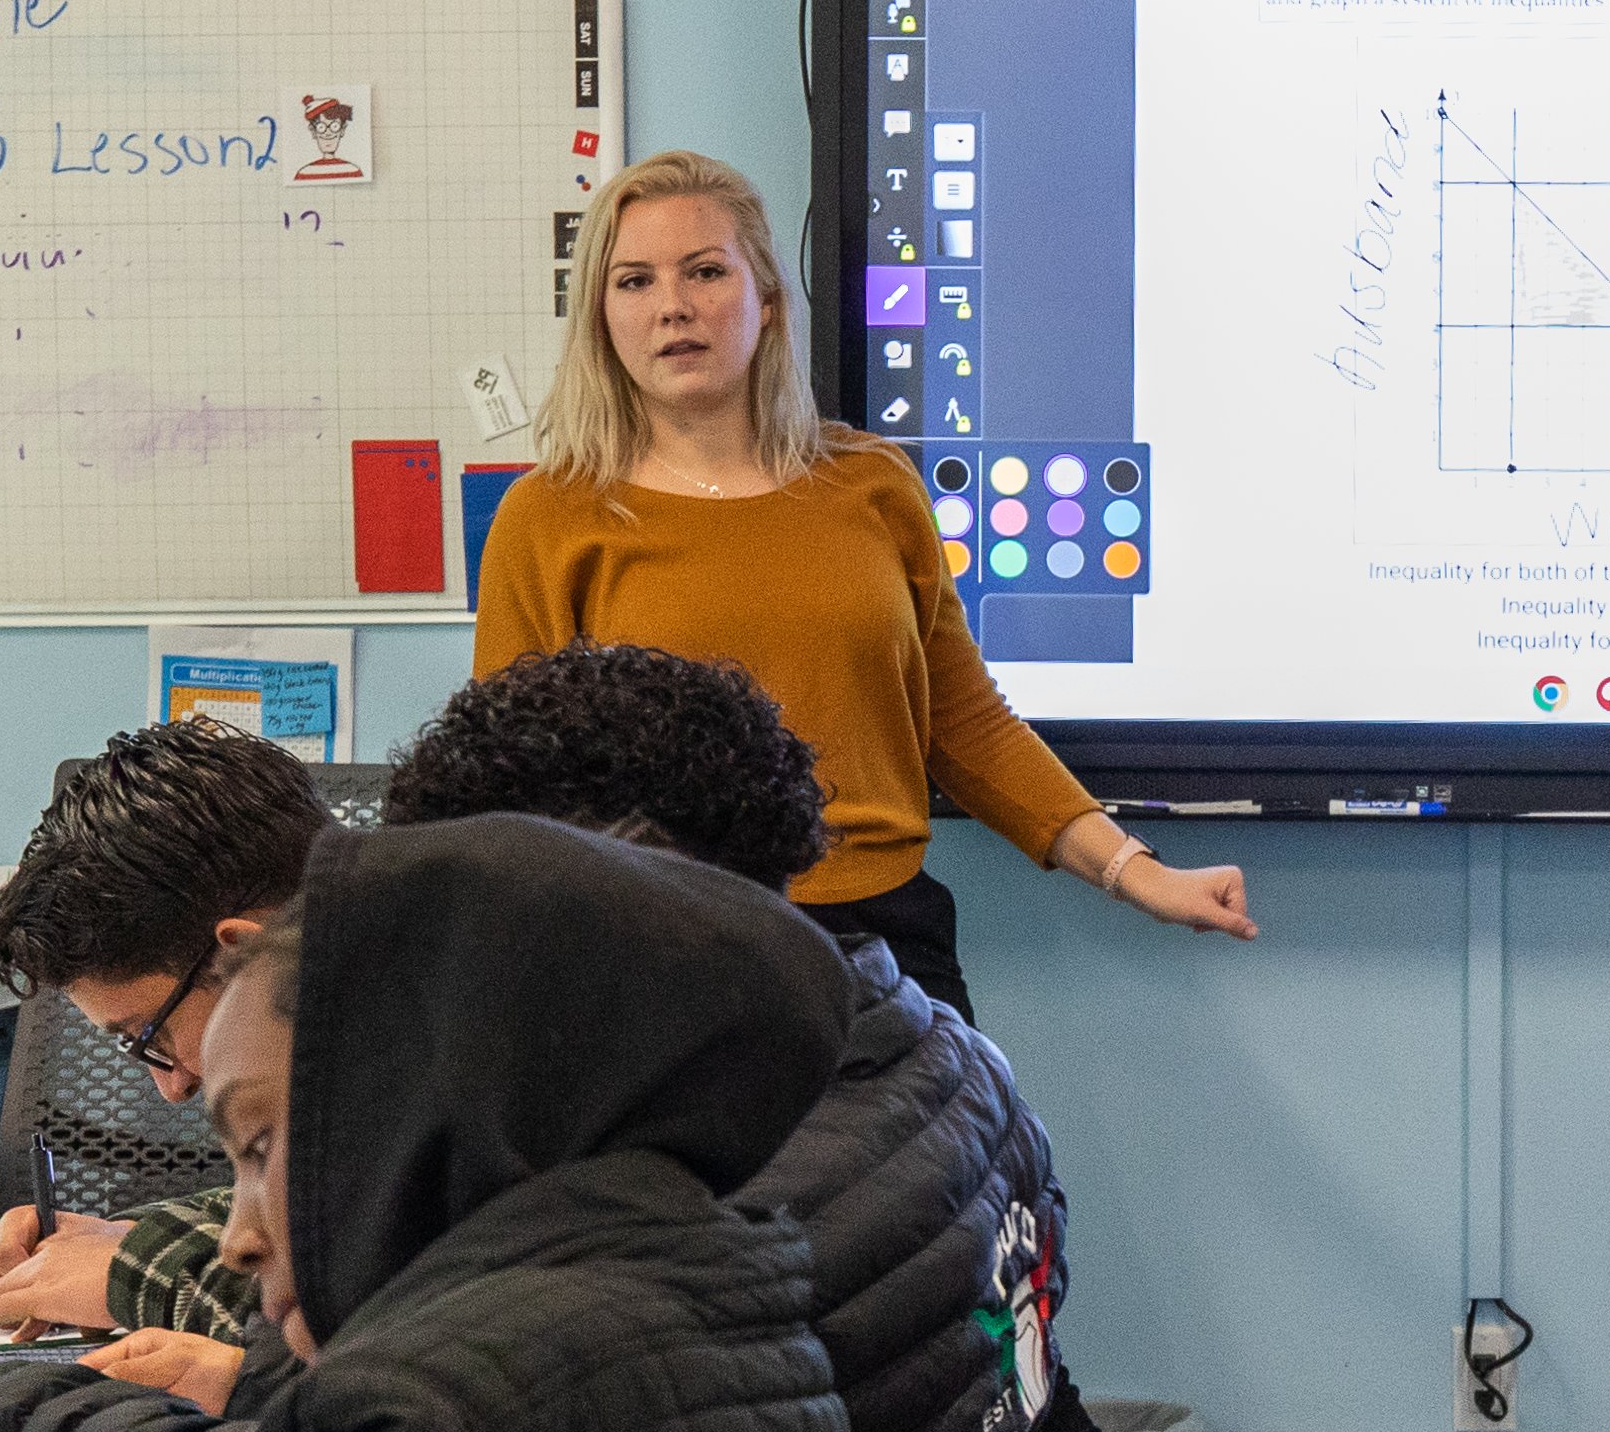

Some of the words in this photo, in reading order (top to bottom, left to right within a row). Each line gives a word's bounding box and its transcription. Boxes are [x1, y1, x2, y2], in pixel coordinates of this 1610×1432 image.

[580, 21, 591, 46] SAT
[581, 70, 592, 96] SUN
[1367, 561, 1474, 584] Inequality
[1481, 562, 1513, 580] for
[1518, 562, 1568, 581] both
[1574, 562, 1595, 581] of
[1501, 597, 1606, 619] Inequality
[1476, 630, 1583, 654] Inequality
